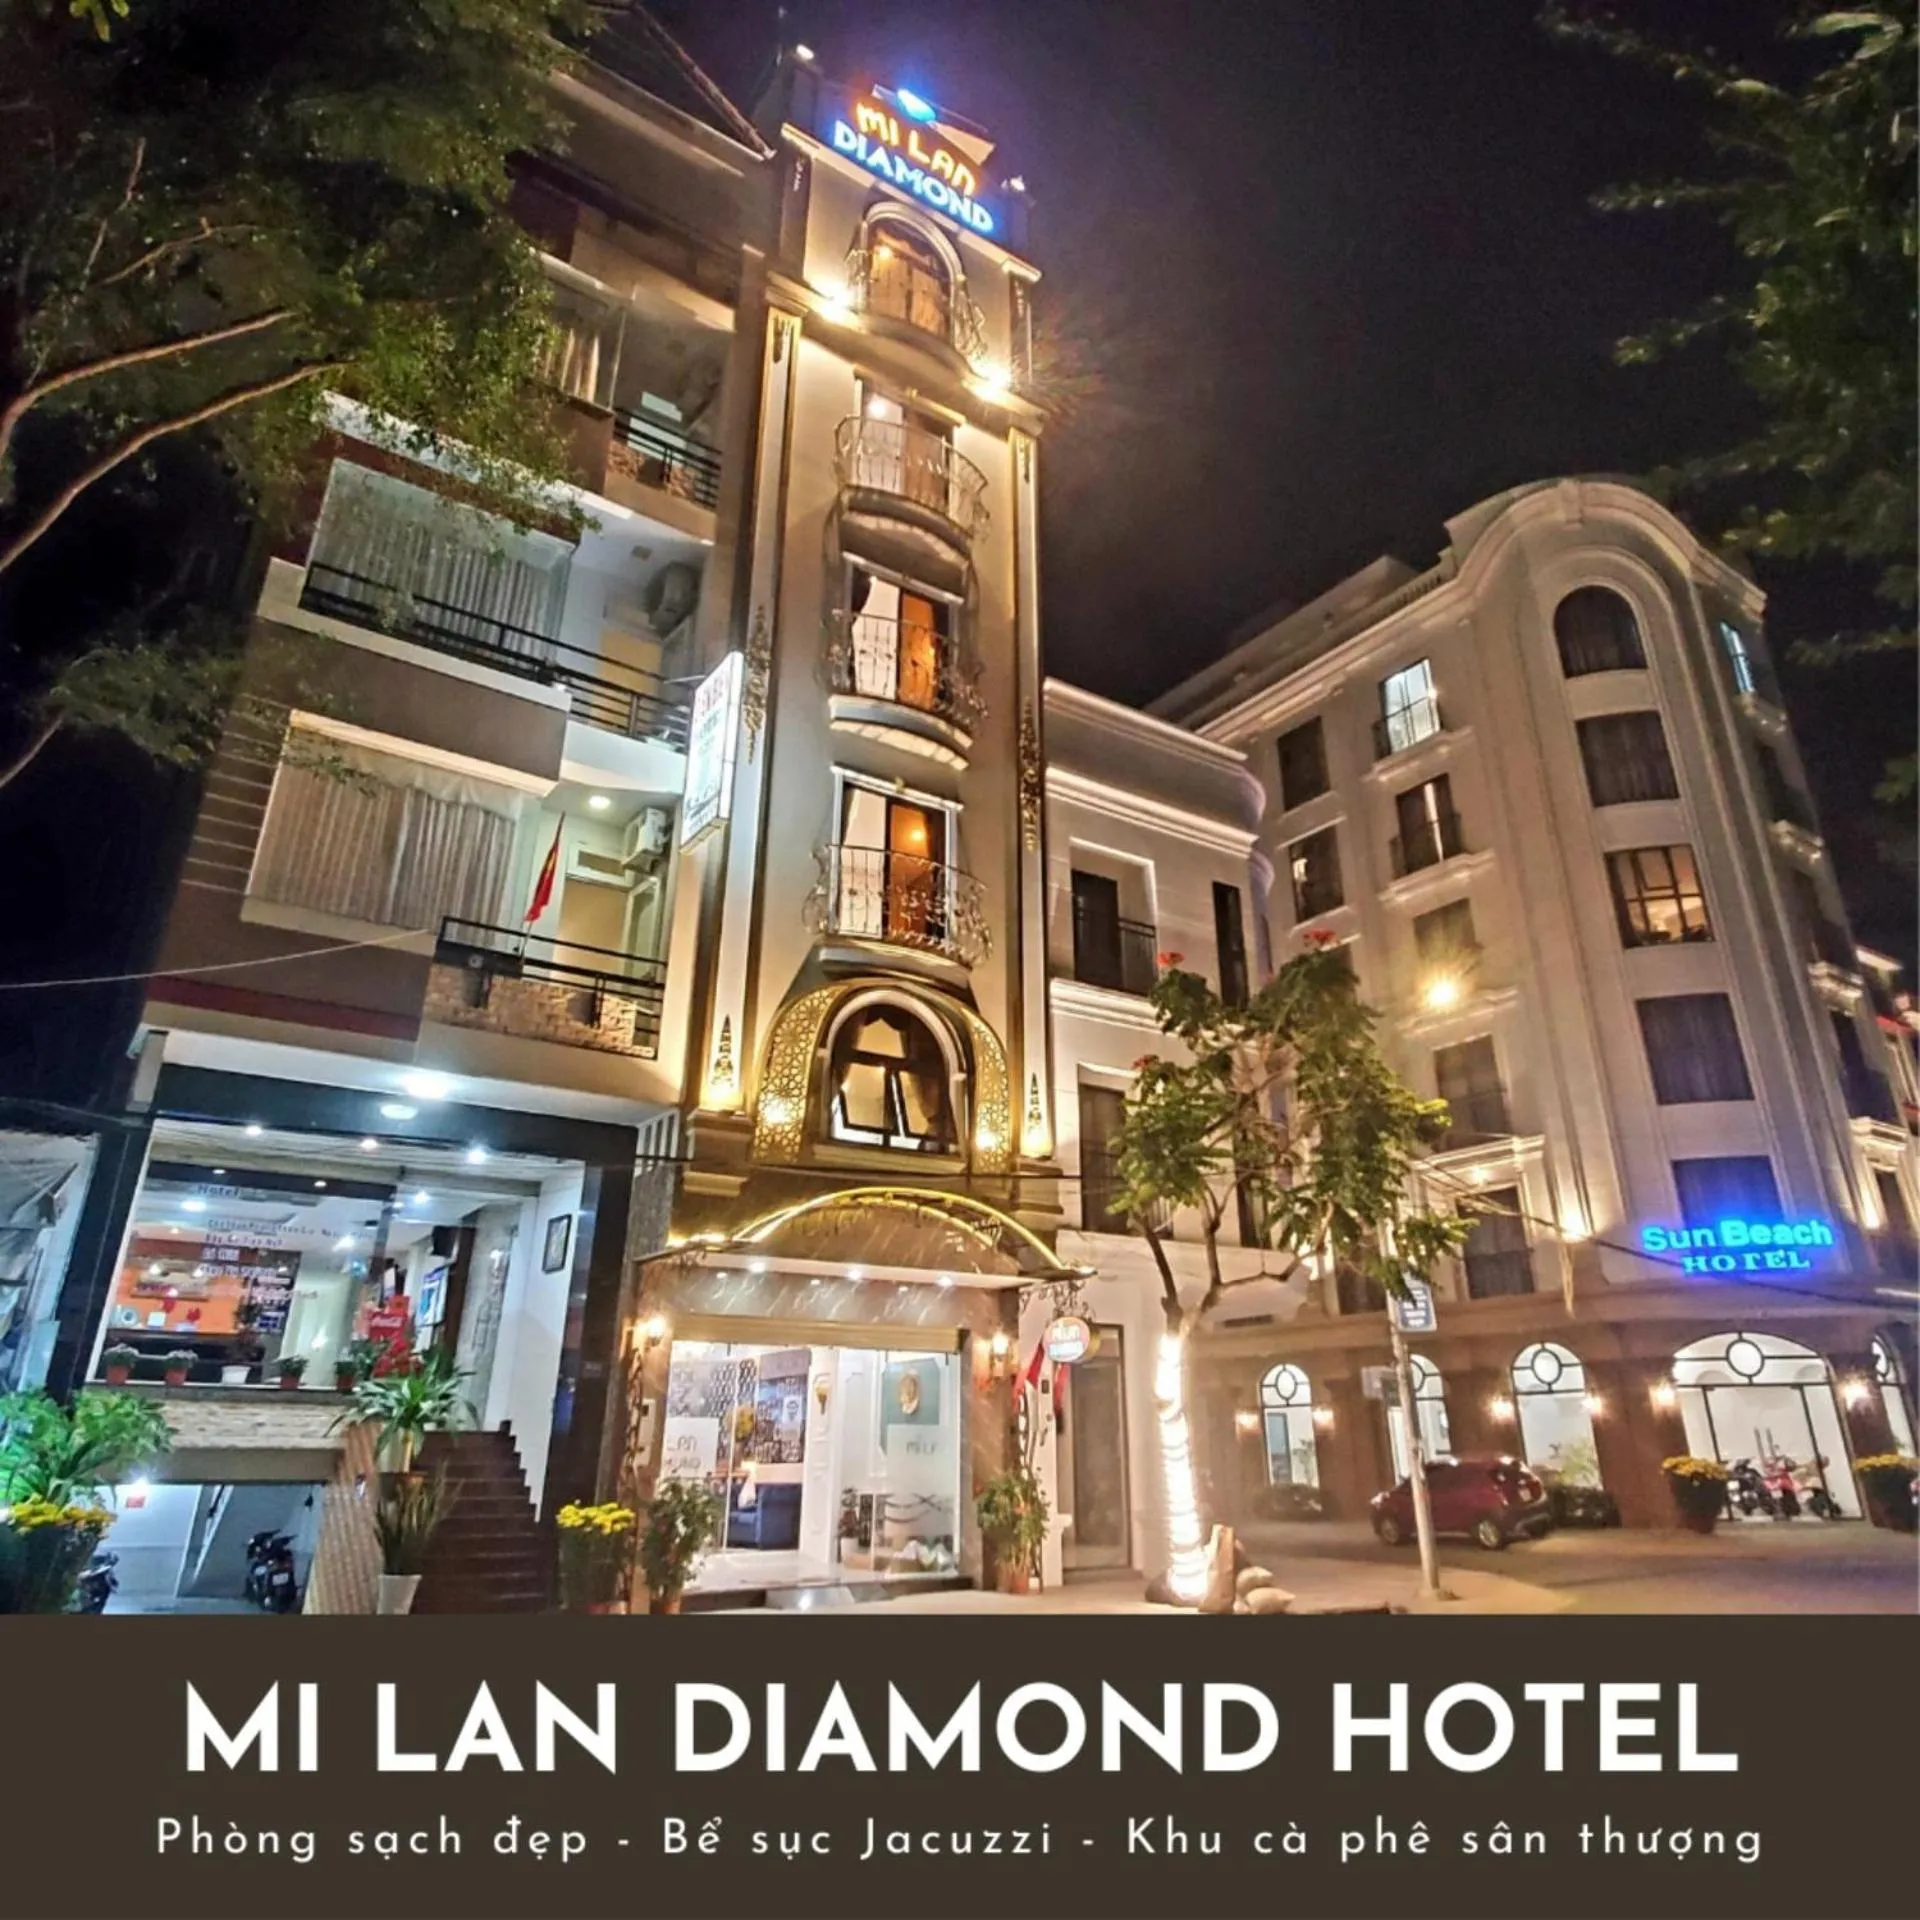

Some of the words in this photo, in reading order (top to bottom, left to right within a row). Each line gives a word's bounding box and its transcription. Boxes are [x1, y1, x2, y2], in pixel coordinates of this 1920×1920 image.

[833, 119, 994, 232] DIAMOND
[855, 101, 899, 147] MI
[907, 129, 977, 196] LAN
[1641, 1226, 1716, 1252] Sun
[1720, 1219, 1834, 1247] Beach
[1682, 1249, 1811, 1274] HOTEL
